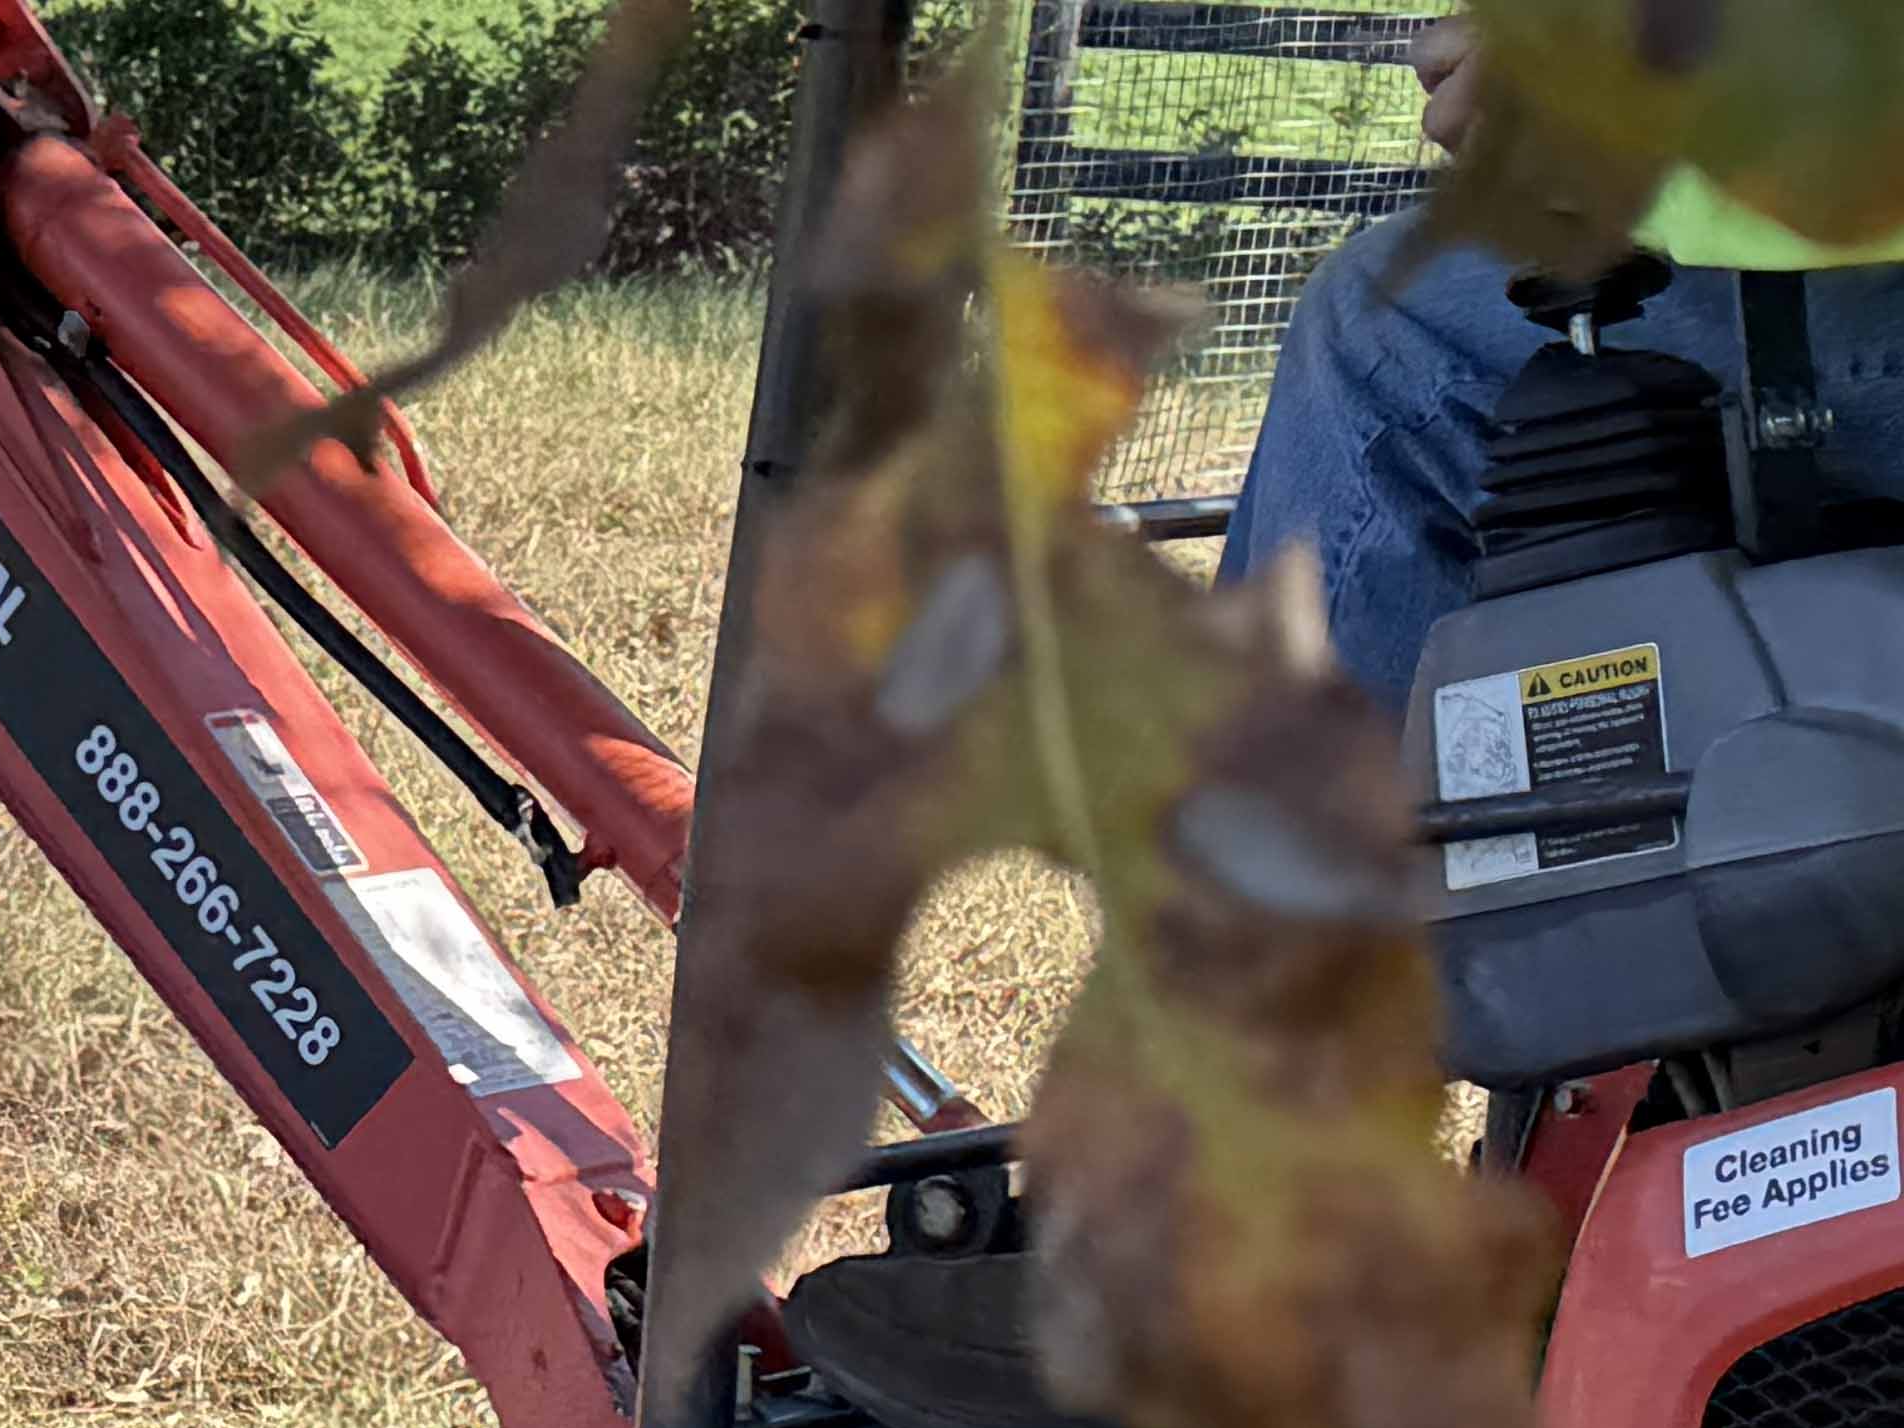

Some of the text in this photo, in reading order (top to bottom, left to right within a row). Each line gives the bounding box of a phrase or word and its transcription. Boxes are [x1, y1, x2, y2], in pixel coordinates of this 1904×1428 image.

[1558, 656, 1648, 689] CAUTION
[76, 725, 340, 1065] 888-266-7228
[1715, 1123, 1862, 1183] Cleaning
[1693, 1154, 1890, 1229] Fee Applies
